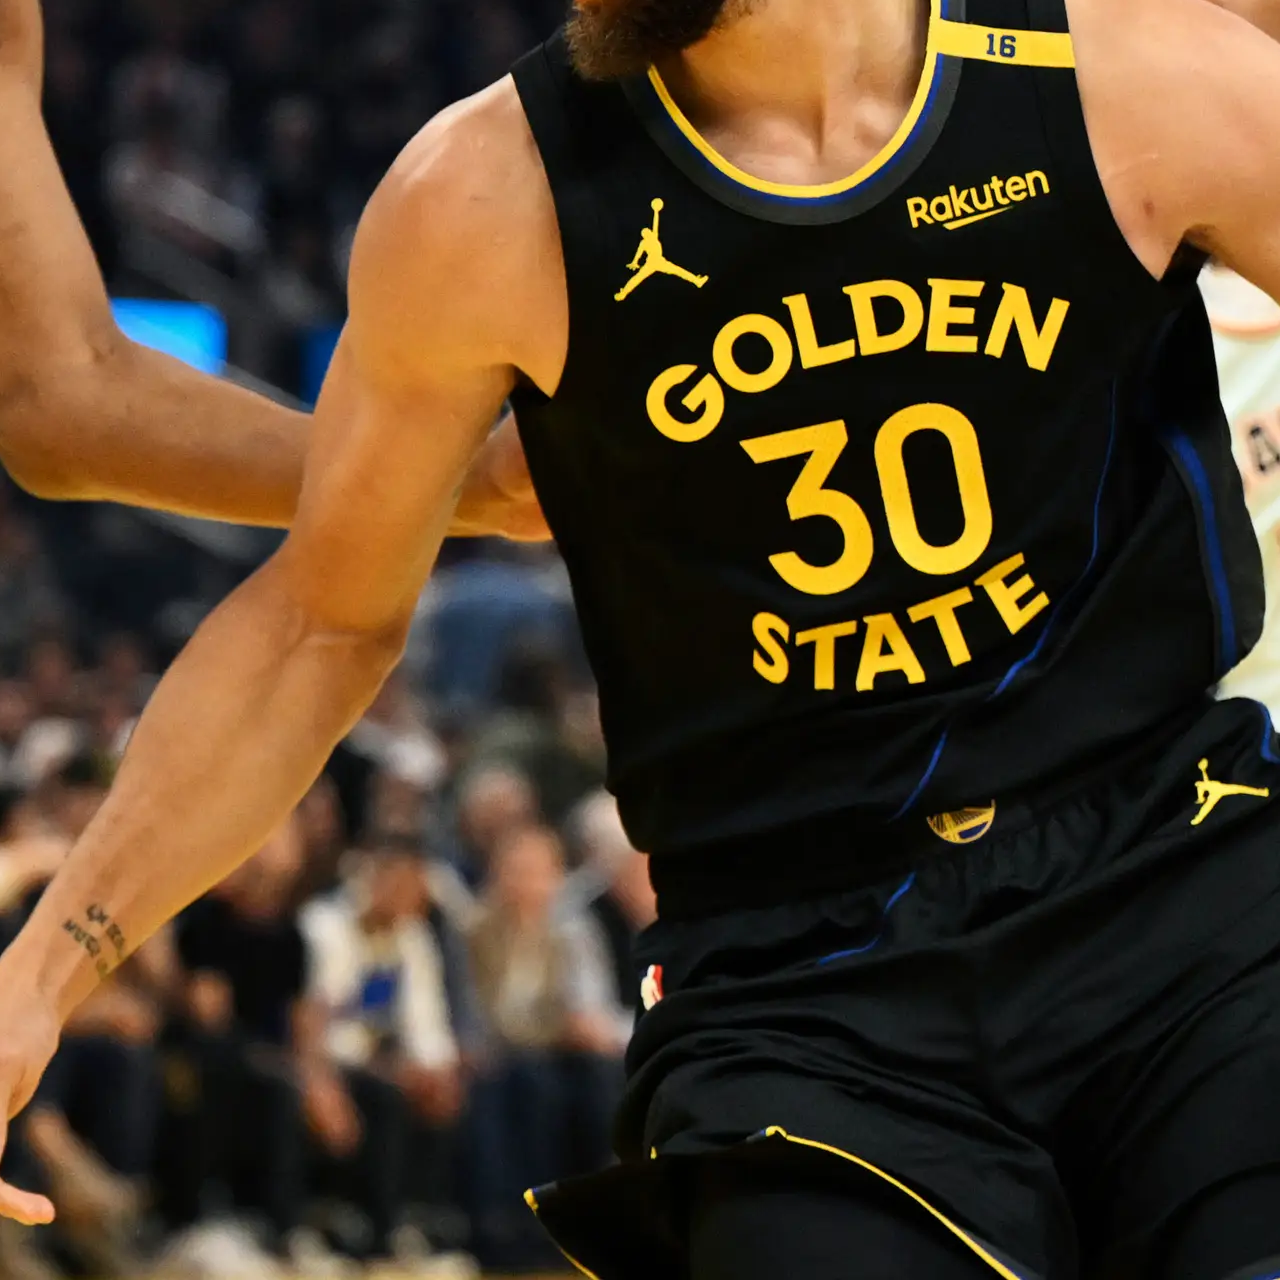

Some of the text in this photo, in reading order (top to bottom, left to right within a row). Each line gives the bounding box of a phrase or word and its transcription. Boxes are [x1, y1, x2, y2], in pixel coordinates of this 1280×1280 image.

[986, 33, 1017, 58] 16
[906, 169, 1051, 230] Rakuten
[645, 277, 1071, 443] GOLDEN
[738, 401, 994, 596] 30
[750, 552, 1050, 692] STATE
